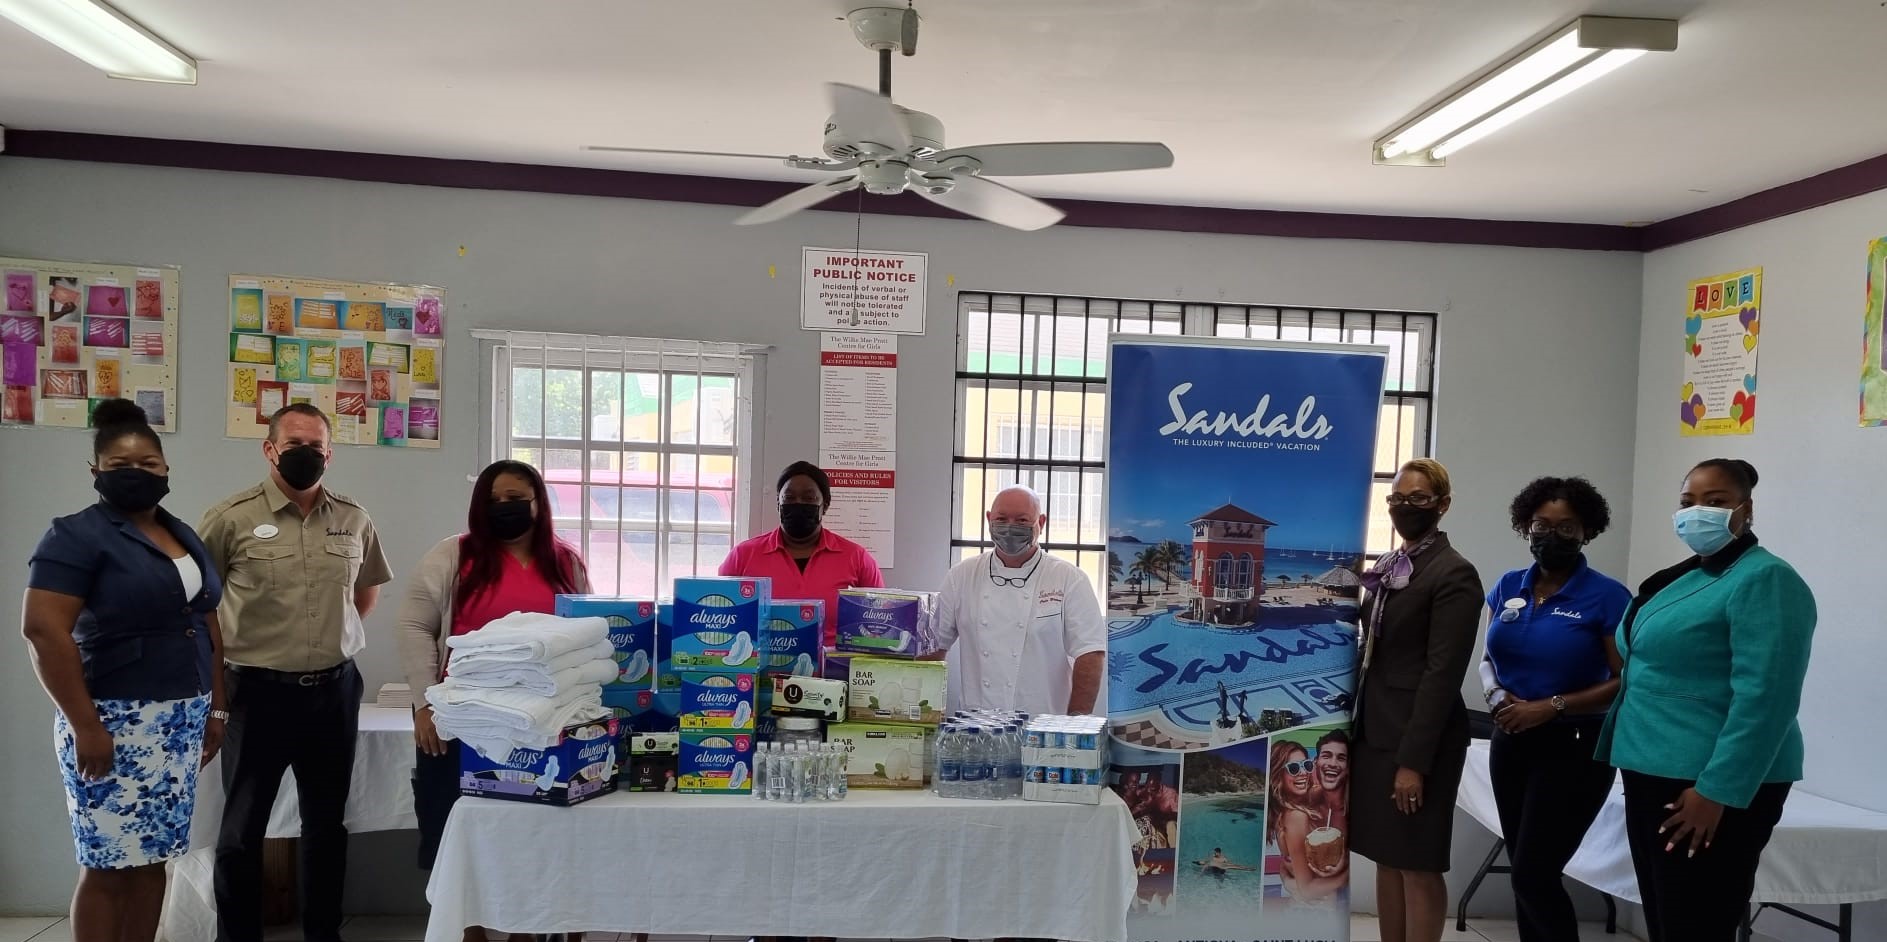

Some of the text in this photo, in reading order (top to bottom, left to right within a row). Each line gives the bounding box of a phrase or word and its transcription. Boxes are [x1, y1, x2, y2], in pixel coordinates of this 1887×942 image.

[826, 256, 905, 269] IMPORTANT
[813, 268, 916, 282] PUBLIC NOTICE
[822, 283, 858, 291] Incidents
[861, 284, 869, 292] of
[872, 285, 896, 293] verbal
[1698, 282, 1749, 304] LOVE
[820, 292, 853, 300] physical
[868, 302, 903, 310] tolerated
[860, 311, 889, 319] subject
[1160, 382, 1333, 440] Sandals
[1173, 438, 1189, 446] THE
[1192, 439, 1224, 447] LUXURY
[1276, 443, 1320, 451] VACATION
[326, 527, 353, 536] Sandals
[690, 609, 737, 628] always
[862, 609, 894, 623] always
[1551, 607, 1581, 618] Sandals
[1135, 627, 1356, 693] Sandals
[856, 671, 873, 679] BAR
[852, 678, 875, 686] SOAP
[697, 690, 738, 706] always
[789, 688, 798, 697] U
[578, 740, 610, 760] always
[695, 750, 736, 767] always
